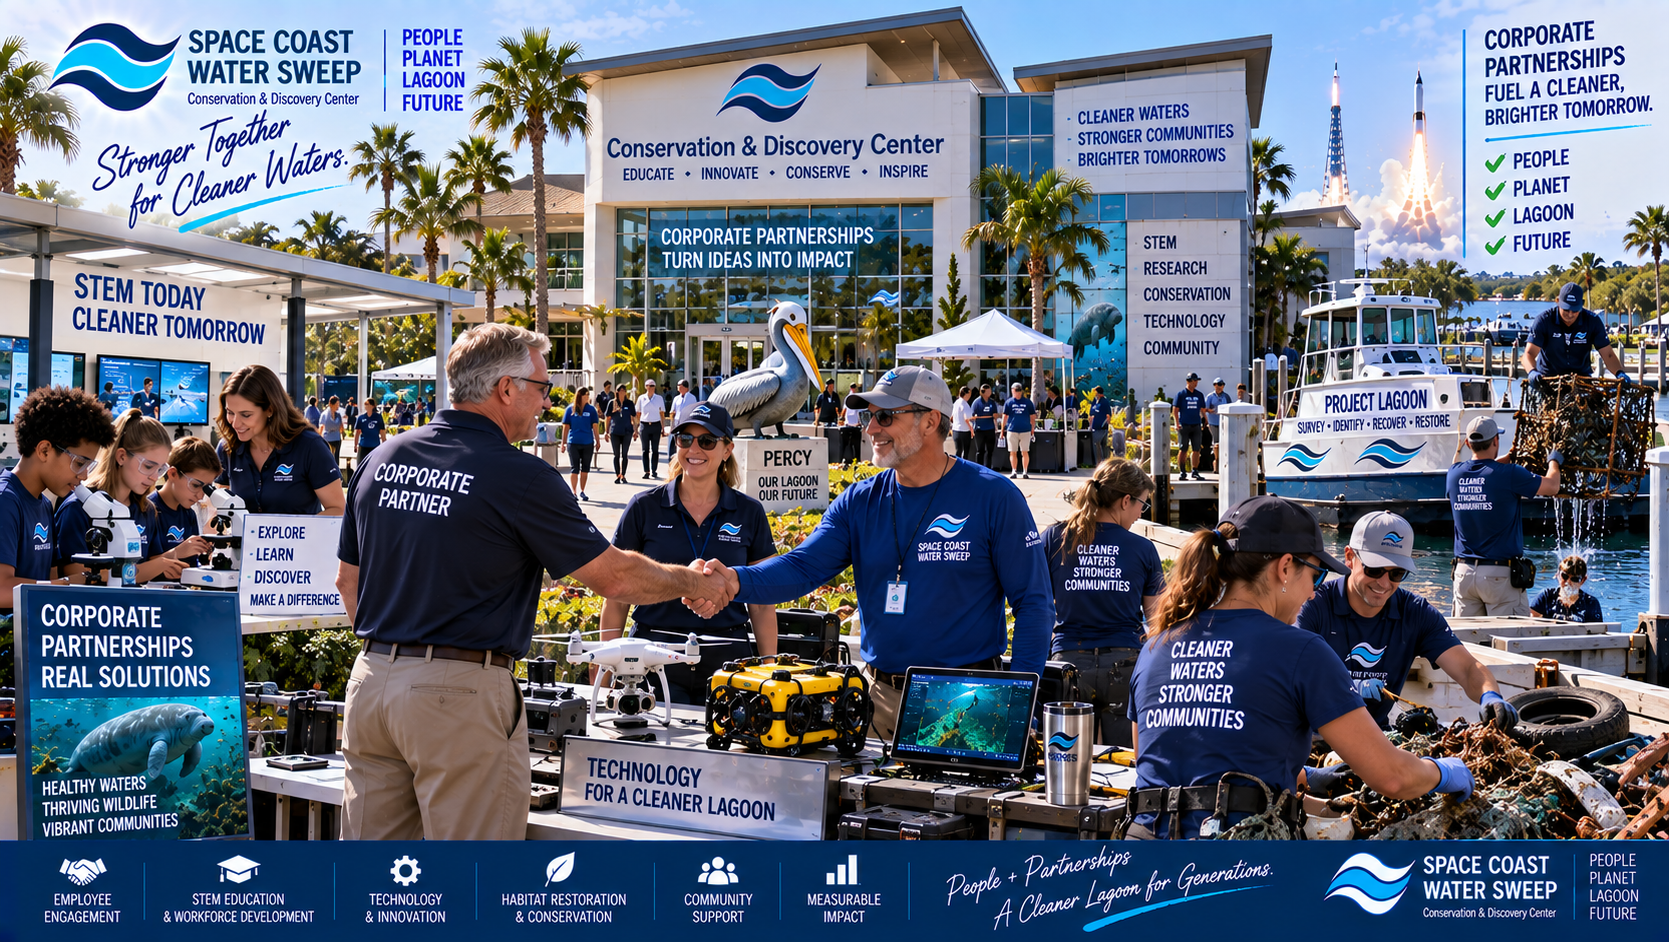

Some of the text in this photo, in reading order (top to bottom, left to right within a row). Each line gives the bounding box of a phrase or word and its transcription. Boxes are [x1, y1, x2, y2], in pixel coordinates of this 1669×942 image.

[1078, 103, 1189, 125] CLEANER WATERS
[1078, 124, 1234, 145] STRONGER COMMUNITIES
[607, 133, 944, 160] Conservation & Discovery Center
[1079, 148, 1226, 166] BRIGHTER TOMORROWS
[624, 165, 928, 181] EDUCATE INNOVATE CONSERVE INSPIRE
[662, 227, 873, 245] CORPORATE PARTNERSHIPS
[1144, 235, 1176, 249] STEM
[662, 251, 853, 268] TURN IDEAS INTO IMPACT
[1144, 261, 1207, 275] RESEARCH
[75, 273, 205, 310] STEM TODAY
[1144, 287, 1230, 301] CONSERVATION
[73, 306, 265, 344] CLEANER TOMORROW
[1144, 314, 1225, 328] TECHNOLOGY
[1144, 341, 1219, 355] COMMUNITY
[1325, 389, 1427, 413] PROJECT LAGOON
[1298, 414, 1450, 434] SURVEY IDENTIFY RECOVER RESTORE
[764, 450, 812, 467] PERCY
[374, 462, 475, 495] CORPORATE
[759, 475, 818, 488] OUR LAGOON
[378, 488, 451, 517] PARTNER
[759, 488, 817, 501] OUR FUTURE
[259, 526, 305, 539] EXPLORE
[256, 548, 293, 561] LEARN
[918, 541, 970, 552] SPACE COAST
[1077, 544, 1119, 555] CLEANER
[918, 552, 970, 561] WATER SWEEP
[1078, 556, 1116, 566] WATERS
[255, 570, 311, 584] DISCOVER
[1065, 580, 1130, 592] COMMUNITIES
[250, 594, 339, 606] MAKE A DIFFERENCE
[41, 604, 162, 628] CORPORATE
[42, 635, 193, 657] PARTNERSHIPS
[1171, 641, 1233, 658] CLEANER
[42, 665, 210, 688] REAL SOLUTIONS
[1171, 662, 1225, 680] WATERS
[1158, 684, 1233, 703] STRONGER
[1146, 707, 1244, 730] COMMUNITIES
[587, 756, 702, 789] TECHNOLOGY
[43, 775, 146, 796] HEALTHY WATERS
[42, 794, 157, 816] THRIVING WILDLIFE
[585, 783, 775, 821] FOR A CLEANER LAGOON
[43, 813, 178, 837] VIBRANT COMMUNITIES
